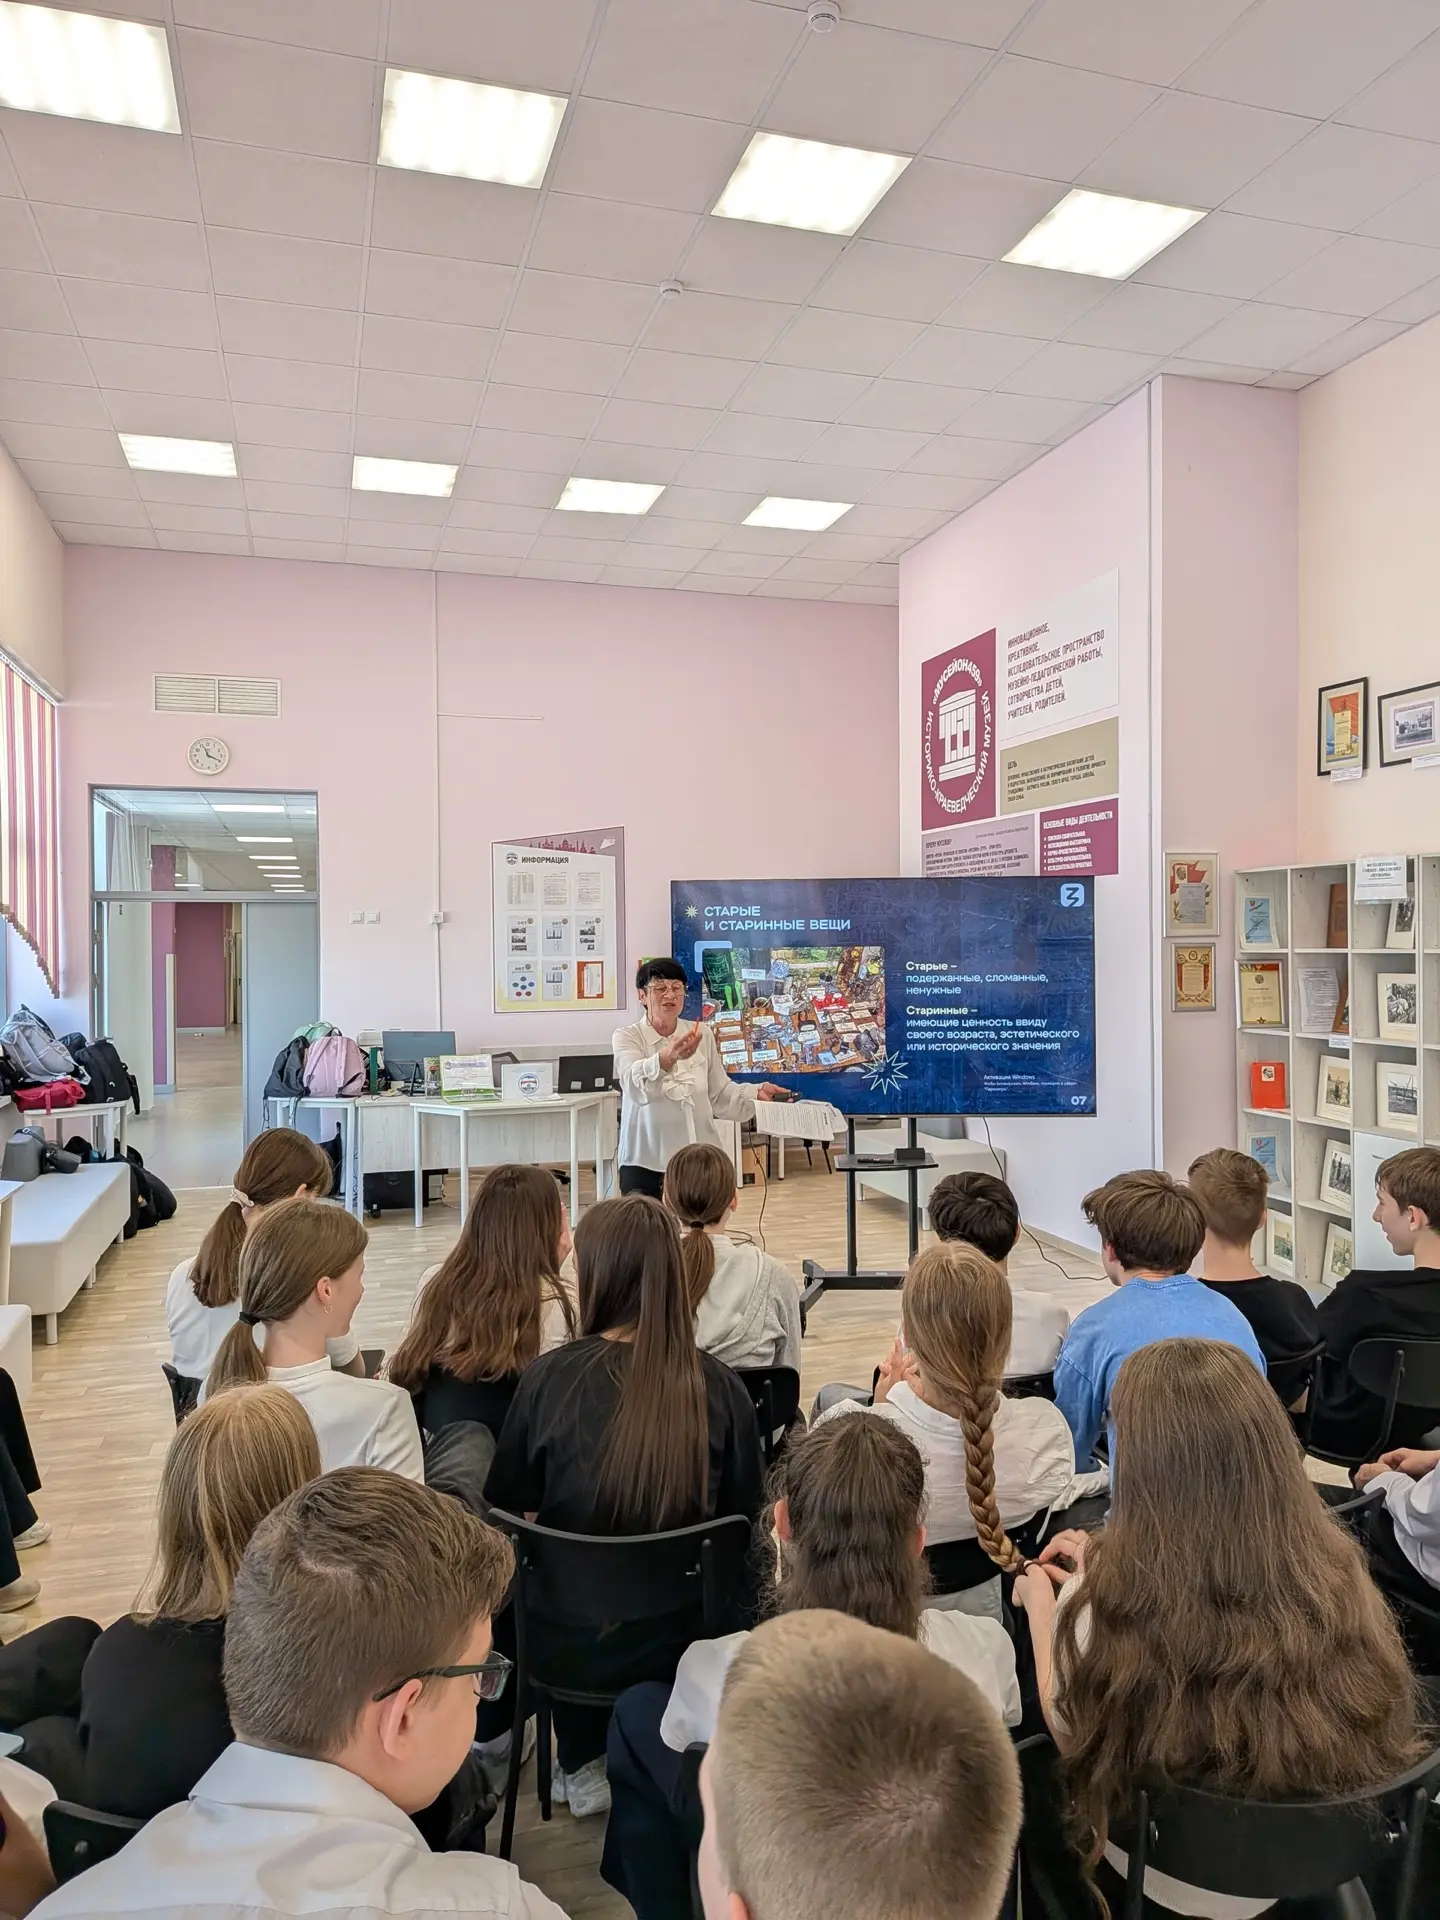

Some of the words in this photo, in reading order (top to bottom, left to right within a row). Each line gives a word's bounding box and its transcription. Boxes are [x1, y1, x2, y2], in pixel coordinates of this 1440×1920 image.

[1008, 623, 1050, 649] ИННОВАЦИОННОЕ,
[1008, 642, 1040, 663] КРЕАТИВНОЕ,
[1008, 648, 1061, 677] ИССЛЕДОВАТЕЛЬСКОЕ
[1062, 629, 1104, 655] ПРОСТРАНСТВО
[1008, 656, 1076, 692] МУЗЕЙНО-ПЕДАГОГИЧЕСКОЙ
[1077, 646, 1103, 665] РАБОТЫ,
[1008, 685, 1044, 706] СОТВОРЧЕСТВА
[1045, 676, 1064, 694] ДЕТЕЙ,
[1008, 702, 1033, 720] УЧИТЕЛЕЙ,
[1035, 690, 1066, 711] РОДИТЕЛЕЙ.
[925, 711, 989, 813] ИСТОРИКО-КРАЕВЕДЧЕСКИЙ
[981, 691, 991, 748] МУЗЕЙ
[522, 856, 569, 864] ИНФОРМАЦИЯ
[704, 906, 761, 917] СТАРЫЕ
[705, 921, 714, 931] И
[719, 920, 805, 931] СТАРИННЫЕ
[810, 920, 851, 932] ВЕЩИ
[906, 962, 948, 973] Старые
[906, 974, 983, 984] подержанные,
[985, 973, 1049, 983] сломанные,
[906, 986, 962, 997] ненужные
[906, 1006, 968, 1017] Старинные
[907, 1019, 960, 1028] имеющие
[962, 1019, 1013, 1028] ценность
[1016, 1019, 1048, 1029] ввиду
[907, 1031, 944, 1039] своего
[947, 1030, 998, 1040] возраста,
[1000, 1030, 1080, 1039] эстетического
[907, 1043, 926, 1051] или
[928, 1042, 1009, 1052] исторического
[1012, 1042, 1061, 1050] значения
[1071, 1096, 1088, 1106] 07
